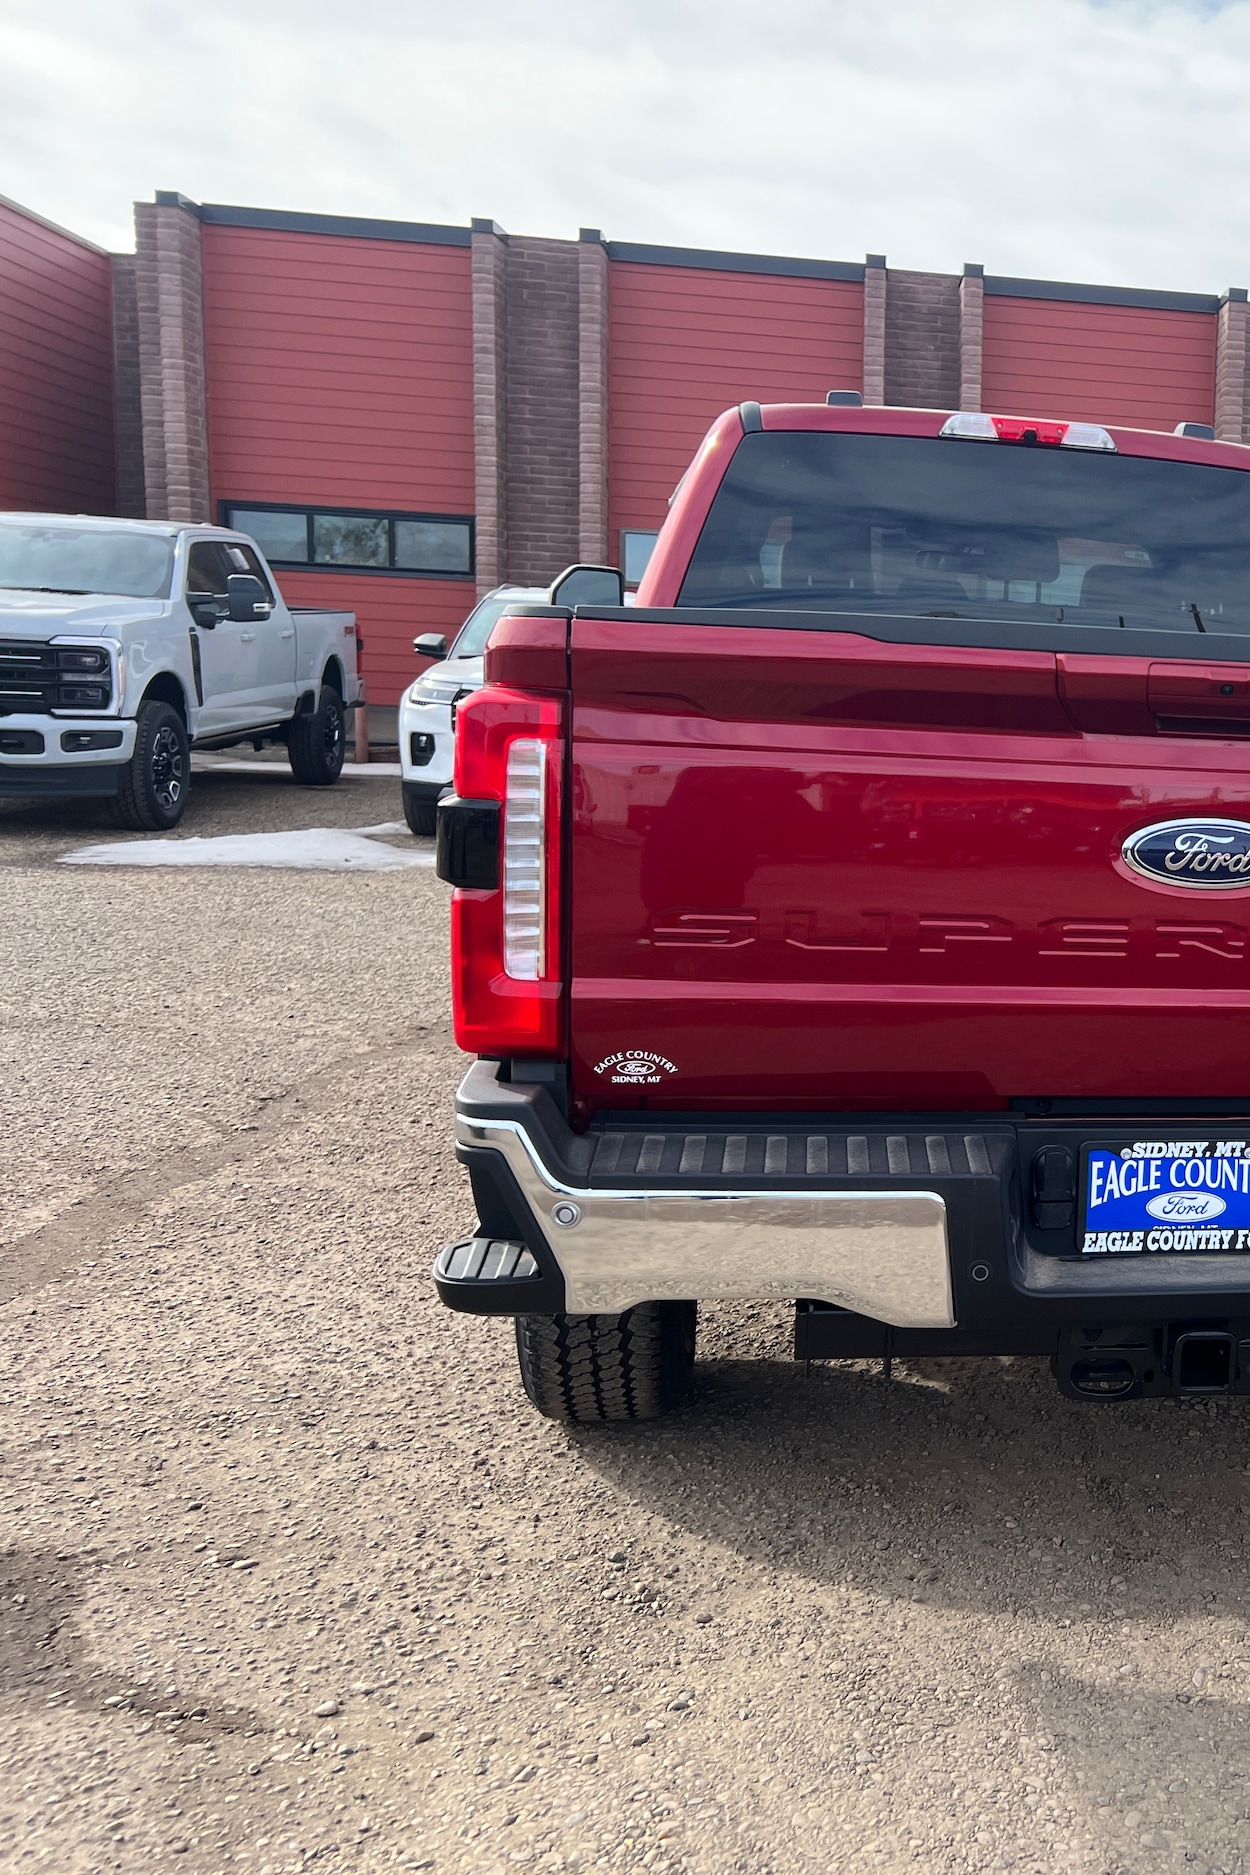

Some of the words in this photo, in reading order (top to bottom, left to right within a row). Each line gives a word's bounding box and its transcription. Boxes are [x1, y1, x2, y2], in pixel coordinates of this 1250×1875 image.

[650, 907, 1247, 960] SUPER
[593, 1052, 625, 1074] EAGLE
[625, 1050, 679, 1074] COUNTRY
[623, 1063, 647, 1073] Ford
[611, 1075, 645, 1084] SIDNEY,
[646, 1075, 662, 1083] MT
[1213, 1142, 1246, 1158] MT
[1090, 1159, 1162, 1209] EAGLE
[1162, 1195, 1210, 1215] Ford
[1082, 1231, 1145, 1253] EAGLE
[1146, 1229, 1235, 1251] COUNTRY
